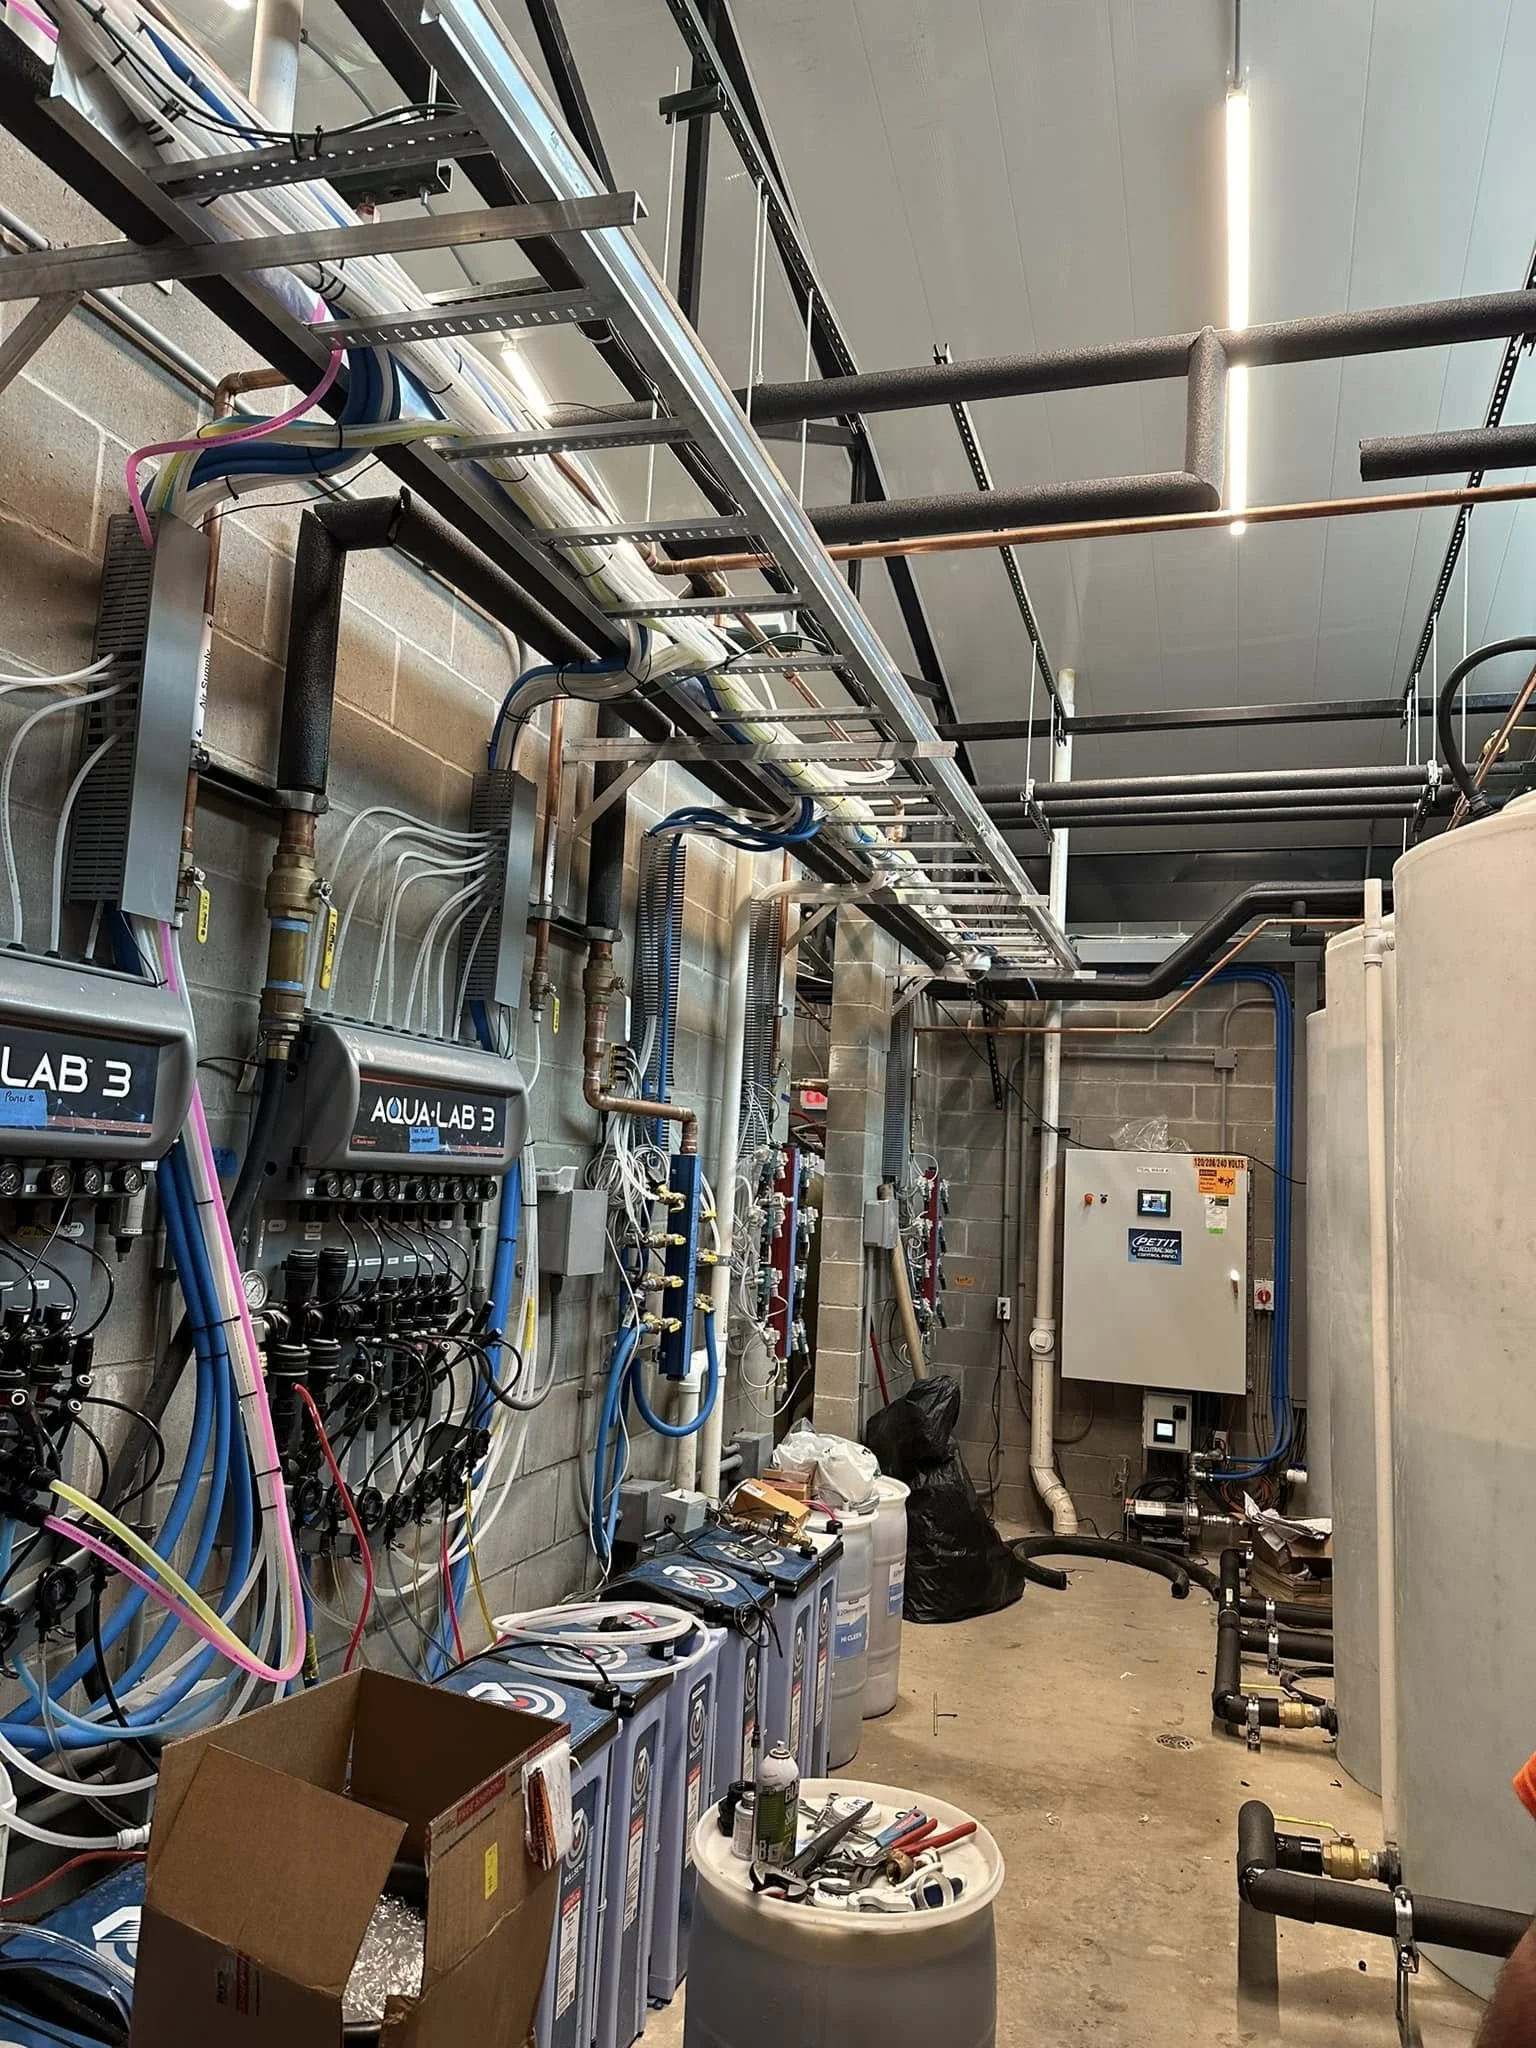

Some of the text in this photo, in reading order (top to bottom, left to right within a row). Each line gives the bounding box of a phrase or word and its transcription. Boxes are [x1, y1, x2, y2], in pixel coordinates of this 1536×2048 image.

[103, 1060, 132, 1098] 3
[480, 1107, 495, 1132] 3
[1229, 1159, 1245, 1168] VOLTS
[1136, 1237, 1179, 1248] PETIT
